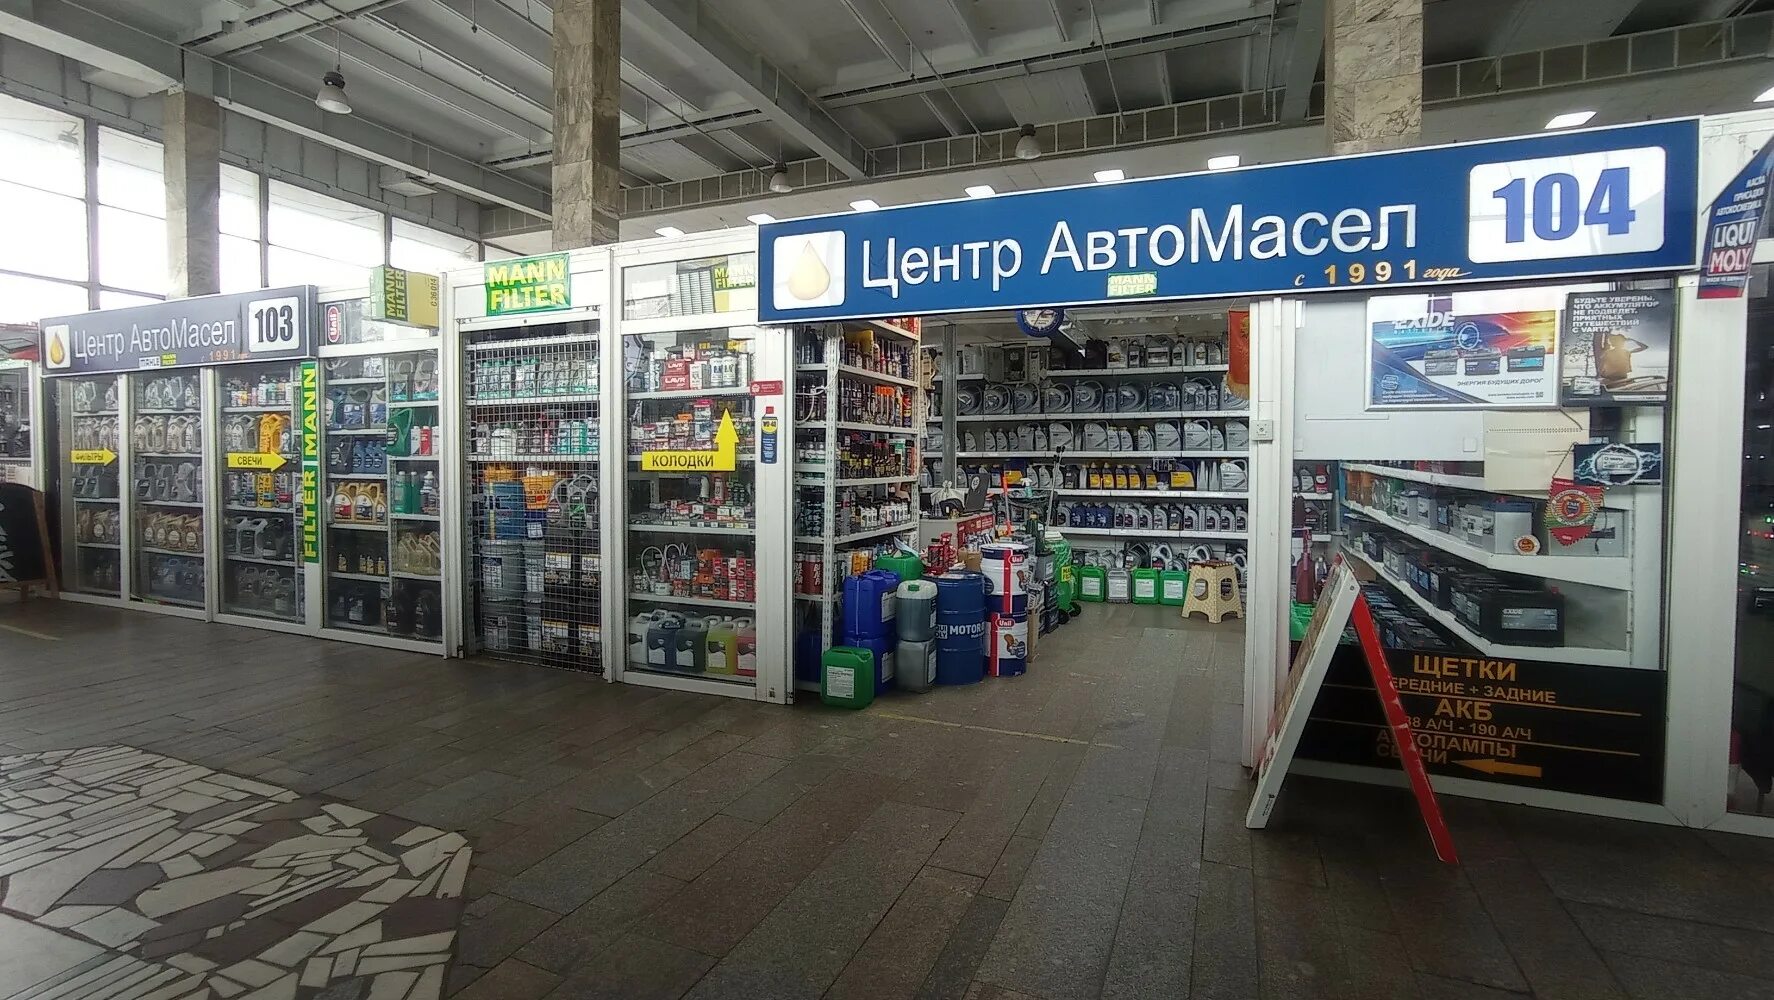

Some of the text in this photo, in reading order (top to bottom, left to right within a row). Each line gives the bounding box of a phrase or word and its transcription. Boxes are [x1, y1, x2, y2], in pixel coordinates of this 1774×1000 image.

[1492, 166, 1637, 244] 104
[1714, 221, 1756, 248] LIQUI
[861, 201, 1418, 300] Центр АвтоМасел
[1710, 248, 1751, 273] MOLY
[488, 259, 566, 288] MANN
[1109, 274, 1156, 286] MANN
[1323, 259, 1417, 286] 1991
[1422, 267, 1473, 282] года
[385, 268, 397, 318] MANN
[395, 269, 406, 319] FILTER
[490, 283, 567, 311] FILTER
[1109, 284, 1155, 296] FILTER
[1593, 300, 1660, 309] АККУМУЛЯТОР
[254, 304, 294, 343] 103
[1393, 311, 1456, 330] EXIDE
[1572, 314, 1623, 322] ПРИЯТНЫХ
[1572, 320, 1640, 328] ПУТЕШЕСТВИЙ
[74, 317, 236, 365] Центр АвтоМасел
[208, 349, 236, 362] 1991
[667, 362, 686, 370] LAVR
[664, 376, 686, 385] LAVR
[303, 368, 317, 456] MANN
[237, 456, 263, 466] СВЕЧИ
[651, 454, 715, 470] КОЛОДКИ
[303, 470, 317, 558] FILTER
[999, 619, 1012, 627] Unil
[1413, 654, 1518, 682] ЩЕТКИ
[1391, 677, 1465, 695] ЕРЕДНИЕ
[1483, 684, 1557, 704] ЗАДНИЕ
[1434, 698, 1494, 722] АКБ
[1425, 717, 1454, 732] А/Ч
[1469, 722, 1497, 737] 190
[1502, 725, 1533, 741] А/Ч
[1376, 729, 1517, 759] АТОЛАМПЫ
